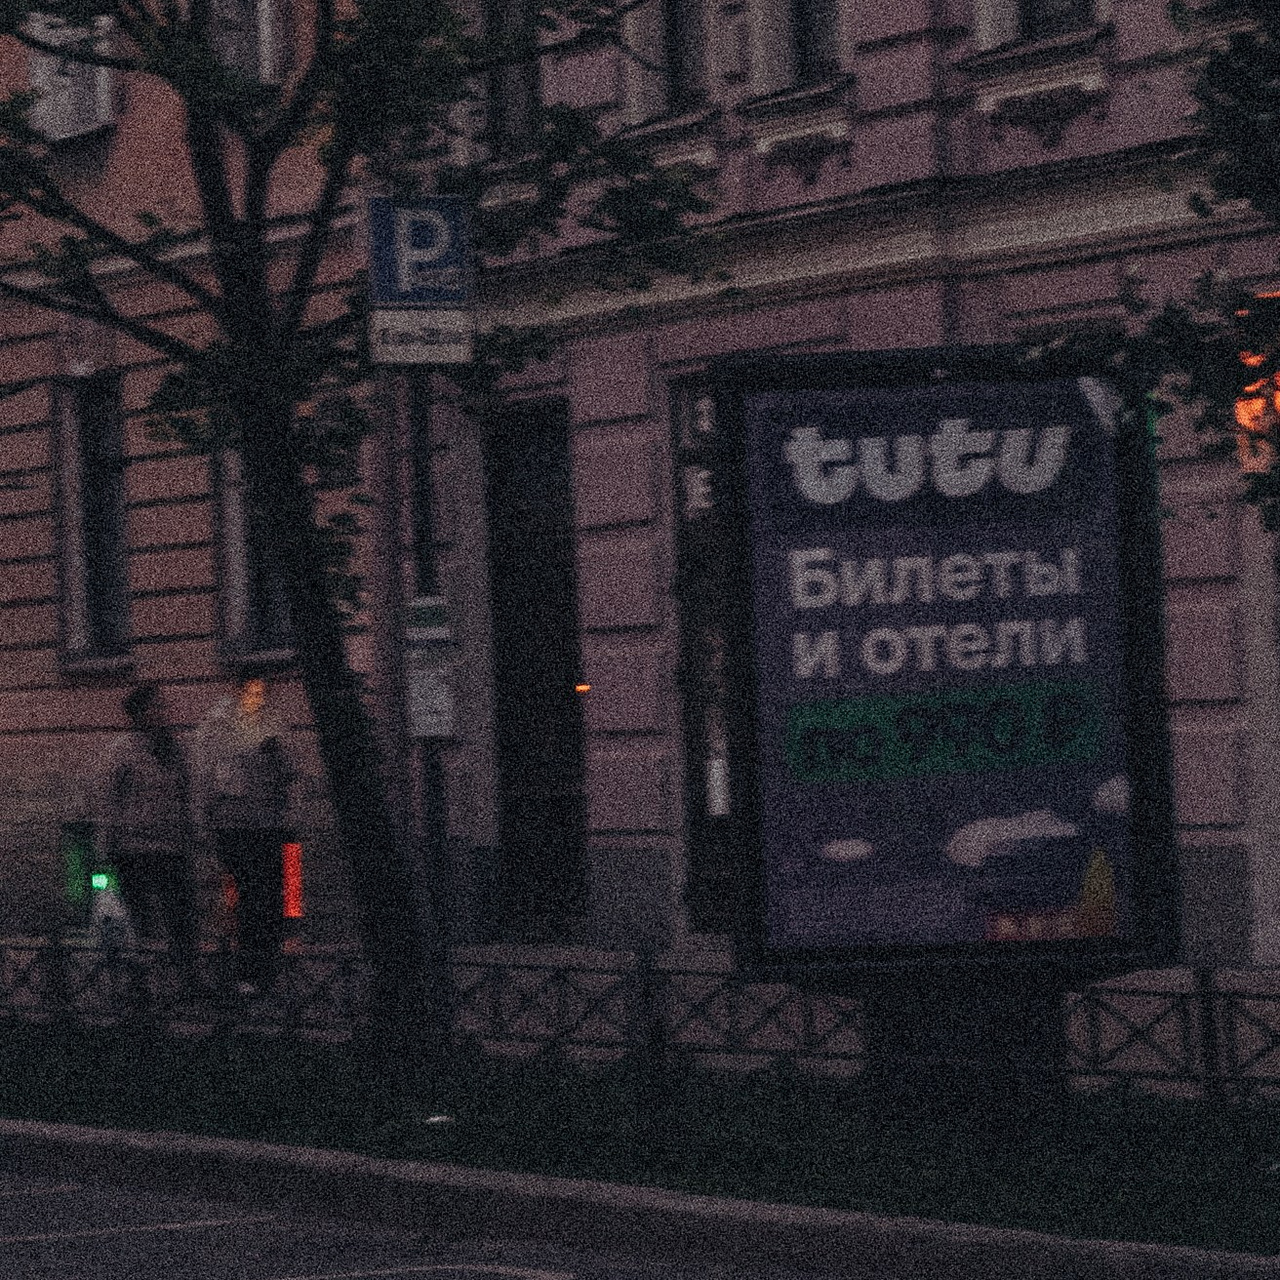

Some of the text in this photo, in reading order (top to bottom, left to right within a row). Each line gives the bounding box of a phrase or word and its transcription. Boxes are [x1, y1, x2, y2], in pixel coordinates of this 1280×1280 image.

[394, 206, 451, 293] P
[783, 417, 1070, 506] tutu
[787, 545, 1081, 611] Билеты
[792, 617, 1087, 679] и отели
[799, 723, 885, 775] по
